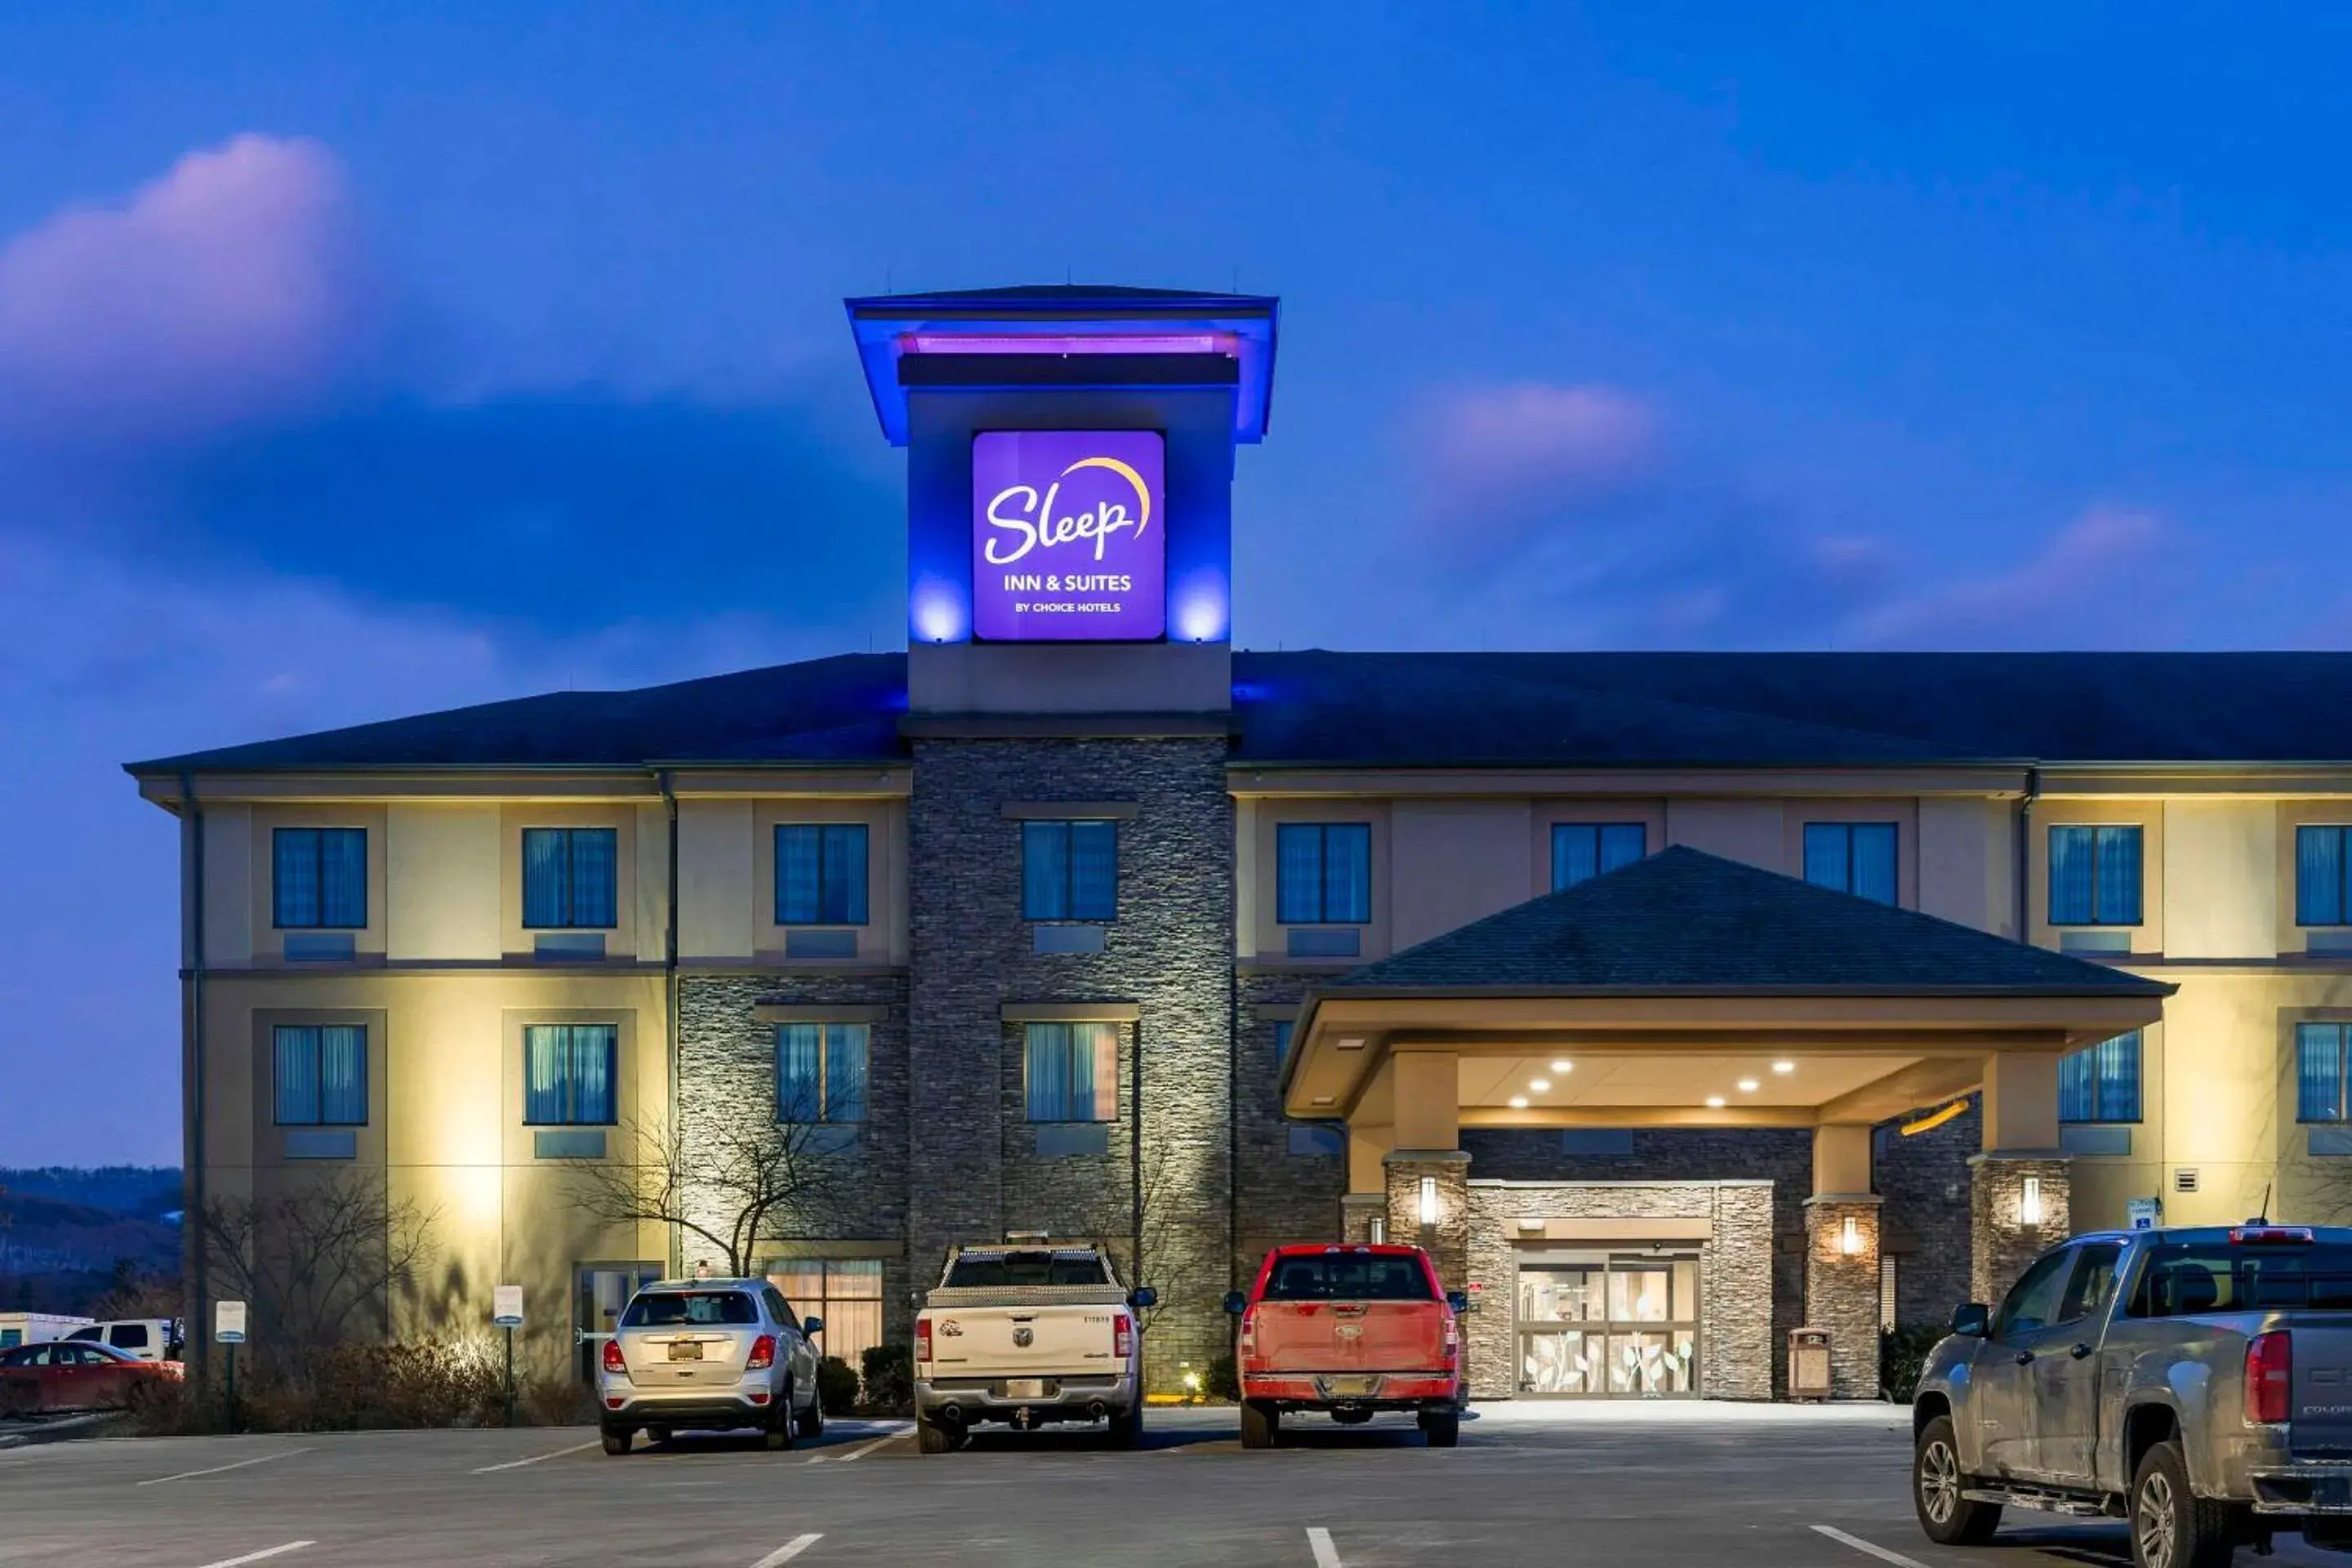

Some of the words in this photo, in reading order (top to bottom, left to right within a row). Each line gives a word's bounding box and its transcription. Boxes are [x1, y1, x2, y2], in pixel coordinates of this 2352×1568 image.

[984, 483, 1134, 564] Sleep
[1004, 575, 1040, 590] INN
[1046, 575, 1061, 591] &
[1065, 575, 1131, 591] SUITES
[1015, 603, 1030, 612] BY
[1033, 603, 1075, 612] CHOICE
[1077, 603, 1120, 612] HOTELS
